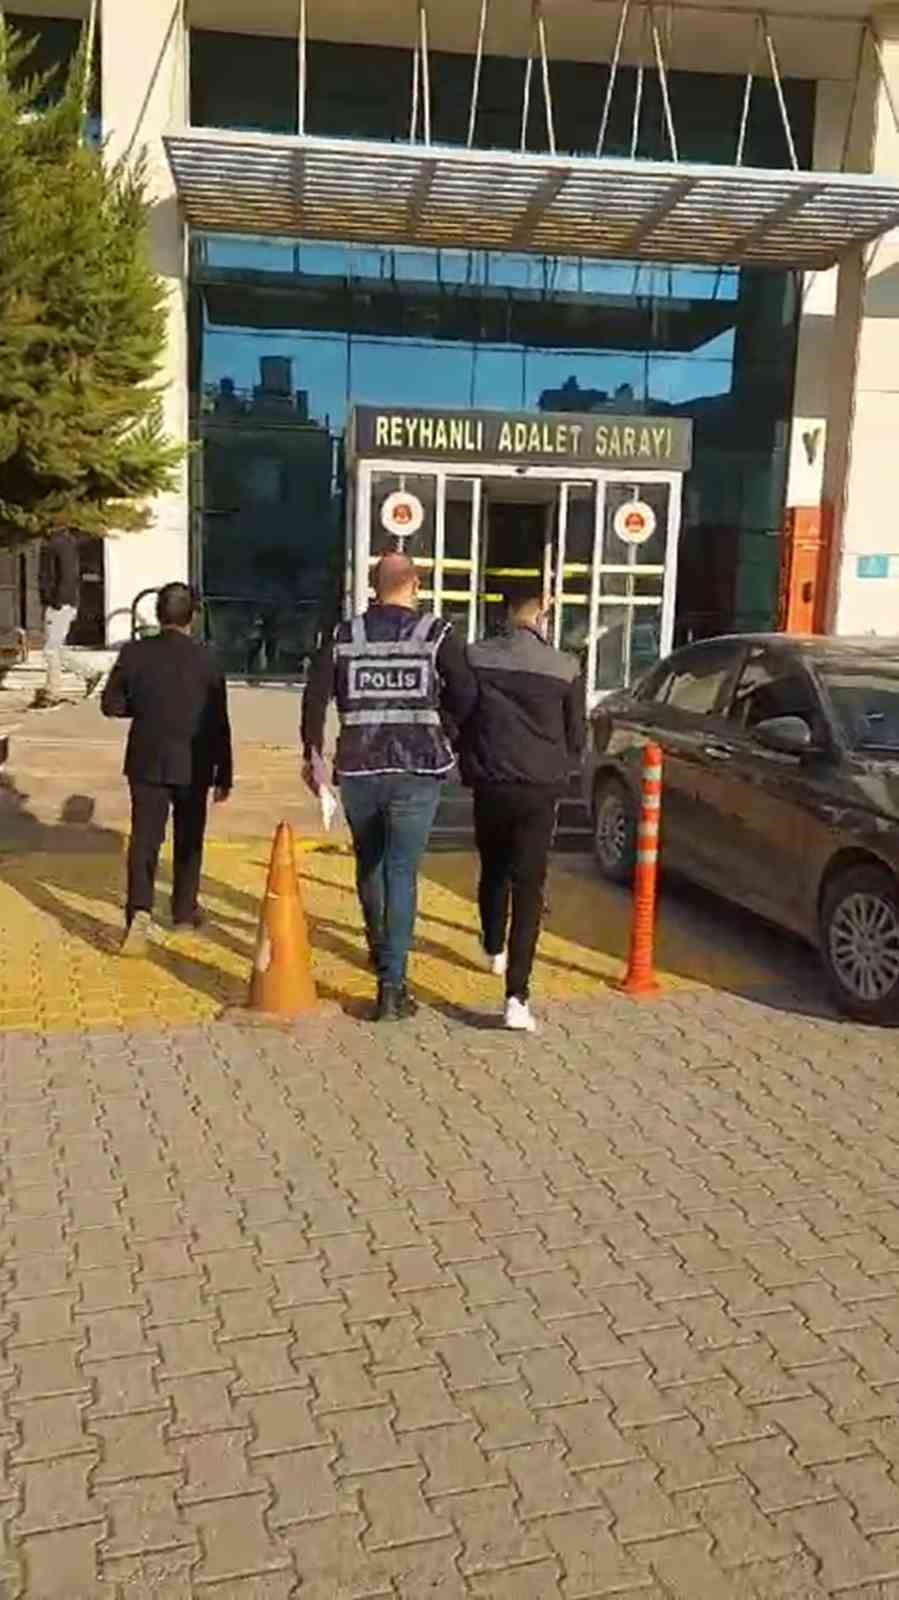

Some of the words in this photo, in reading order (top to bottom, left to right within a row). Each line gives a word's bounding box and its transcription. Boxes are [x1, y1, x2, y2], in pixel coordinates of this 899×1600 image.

[375, 415, 483, 450] REYHANLI
[498, 424, 582, 454] ADALET
[595, 426, 672, 457] SARAYI
